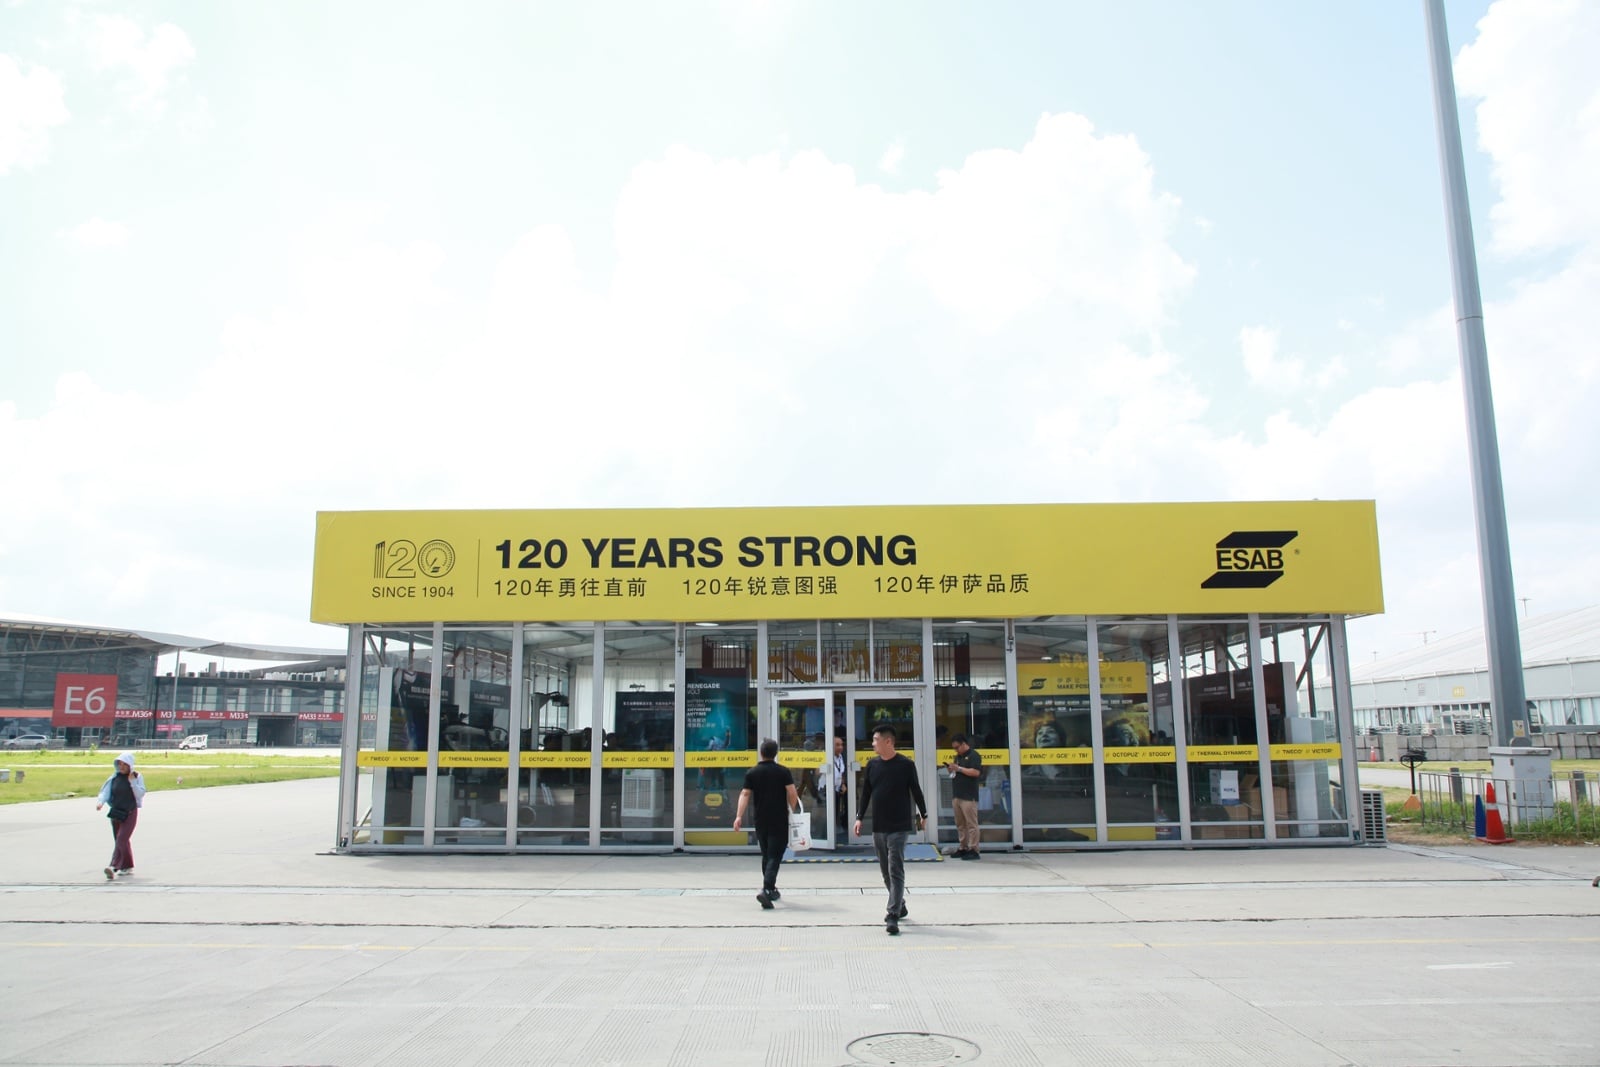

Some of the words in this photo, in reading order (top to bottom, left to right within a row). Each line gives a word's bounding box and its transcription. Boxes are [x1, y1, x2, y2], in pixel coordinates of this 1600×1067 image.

[495, 538, 569, 570] 120
[581, 536, 724, 569] YEARS
[737, 534, 917, 568] STRONG
[1216, 549, 1284, 571] ESAB
[371, 586, 417, 600] SINCE
[421, 585, 455, 599] 1904
[494, 576, 648, 598] 120年勇往直前
[682, 575, 838, 597] 120年锐意图强
[874, 573, 1030, 595] 120年伊萨品质
[64, 686, 106, 715] E6
